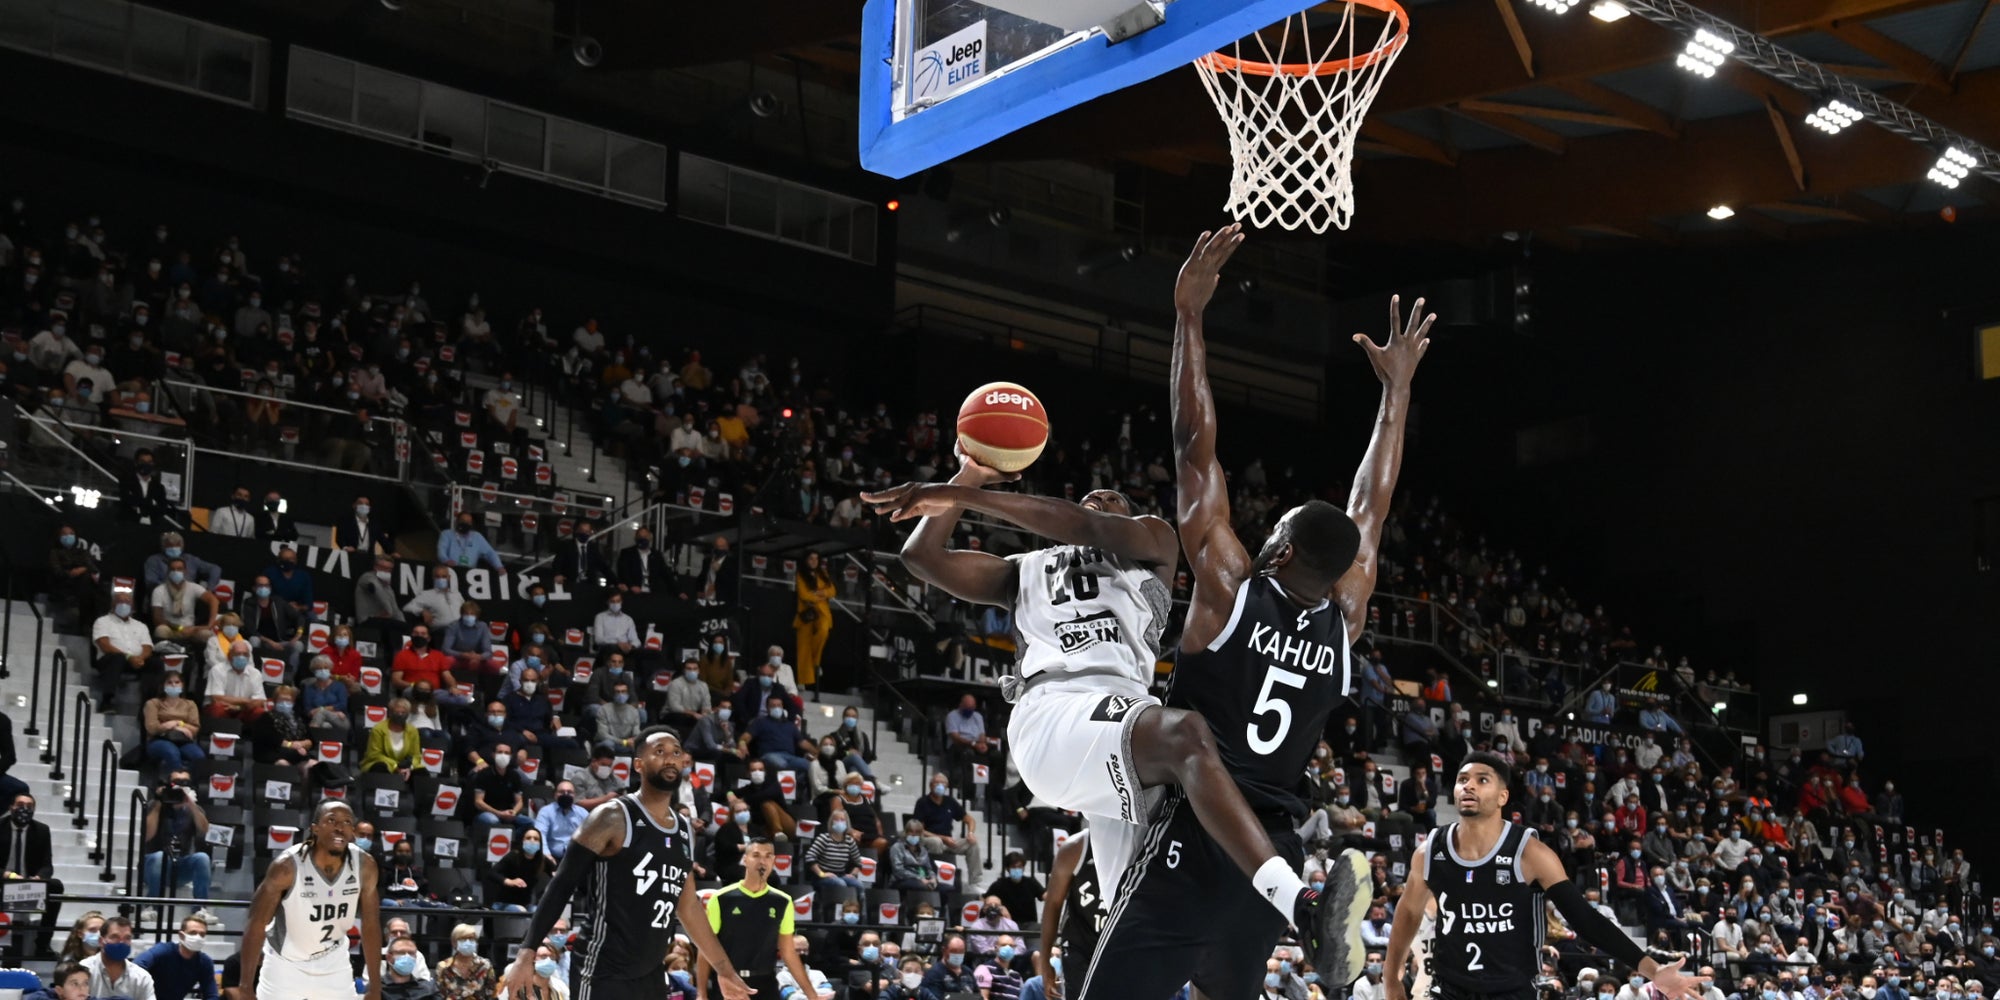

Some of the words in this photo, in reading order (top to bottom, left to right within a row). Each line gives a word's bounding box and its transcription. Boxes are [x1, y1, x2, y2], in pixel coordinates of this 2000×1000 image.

[946, 39, 982, 66] Jeep
[948, 60, 980, 85] ÉLITE
[985, 391, 1034, 410] Jeep
[1051, 572, 1100, 605] 10
[1246, 664, 1307, 755] 5
[1105, 752, 1133, 822] erviStores
[1167, 840, 1182, 869] 5
[310, 903, 349, 922] JDA
[651, 899, 674, 928] 23
[1461, 903, 1513, 919] LDLC
[320, 925, 334, 943] 2
[1463, 919, 1515, 934] ASVEL
[1466, 942, 1484, 971] 2
